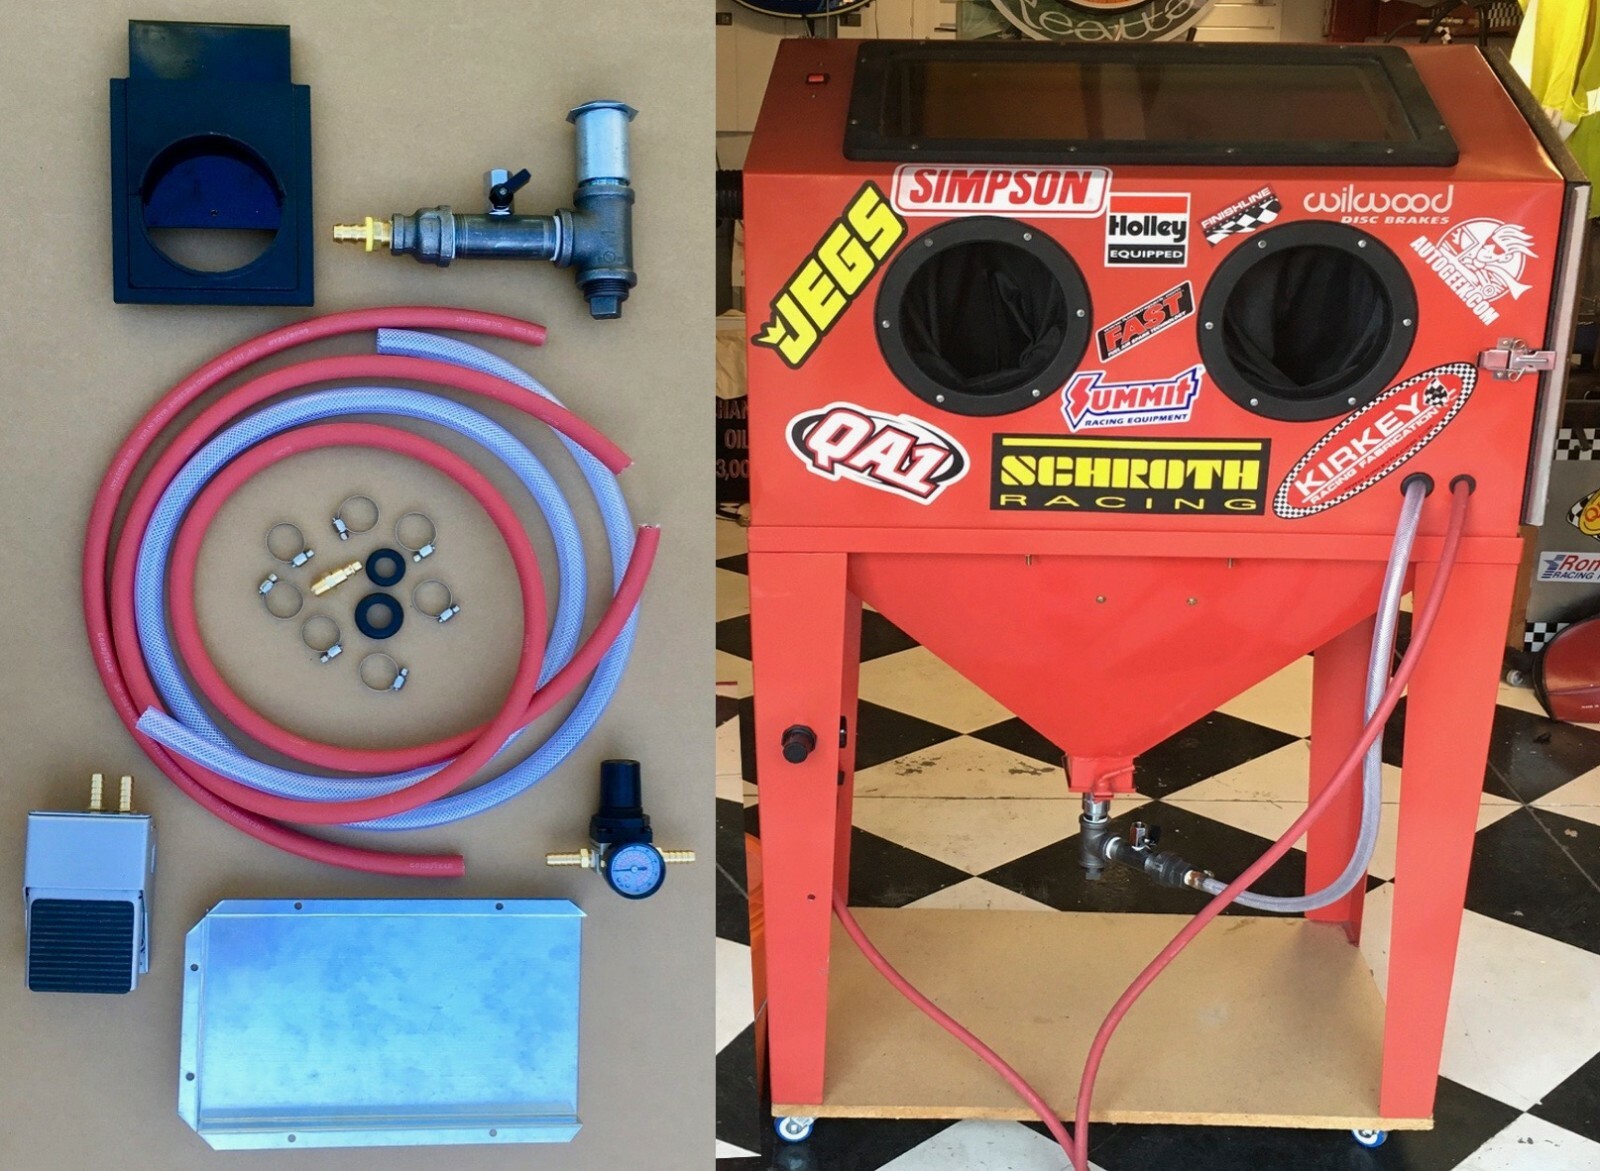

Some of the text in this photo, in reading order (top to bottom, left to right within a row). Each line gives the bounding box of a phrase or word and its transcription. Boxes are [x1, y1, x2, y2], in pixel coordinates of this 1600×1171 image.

[909, 168, 1093, 206] SIMPSON
[1303, 184, 1454, 213] wilwood
[1200, 186, 1272, 229] FINISHLINE
[1341, 215, 1450, 225] DISC BRAKES
[1108, 215, 1187, 243] Holley
[1109, 250, 1183, 259] EQUIPPED
[768, 184, 905, 366] JEGS
[1104, 290, 1183, 352] FAST
[1084, 413, 1188, 427] RACING EQUIPMENT
[805, 407, 951, 499] QA1
[1294, 392, 1421, 497] KIRKEY
[1309, 407, 1440, 504] RACING FABRICATION
[1001, 455, 1260, 490] SCHROTH
[1000, 494, 1257, 510] RACING
[1553, 571, 1594, 580] RACING
